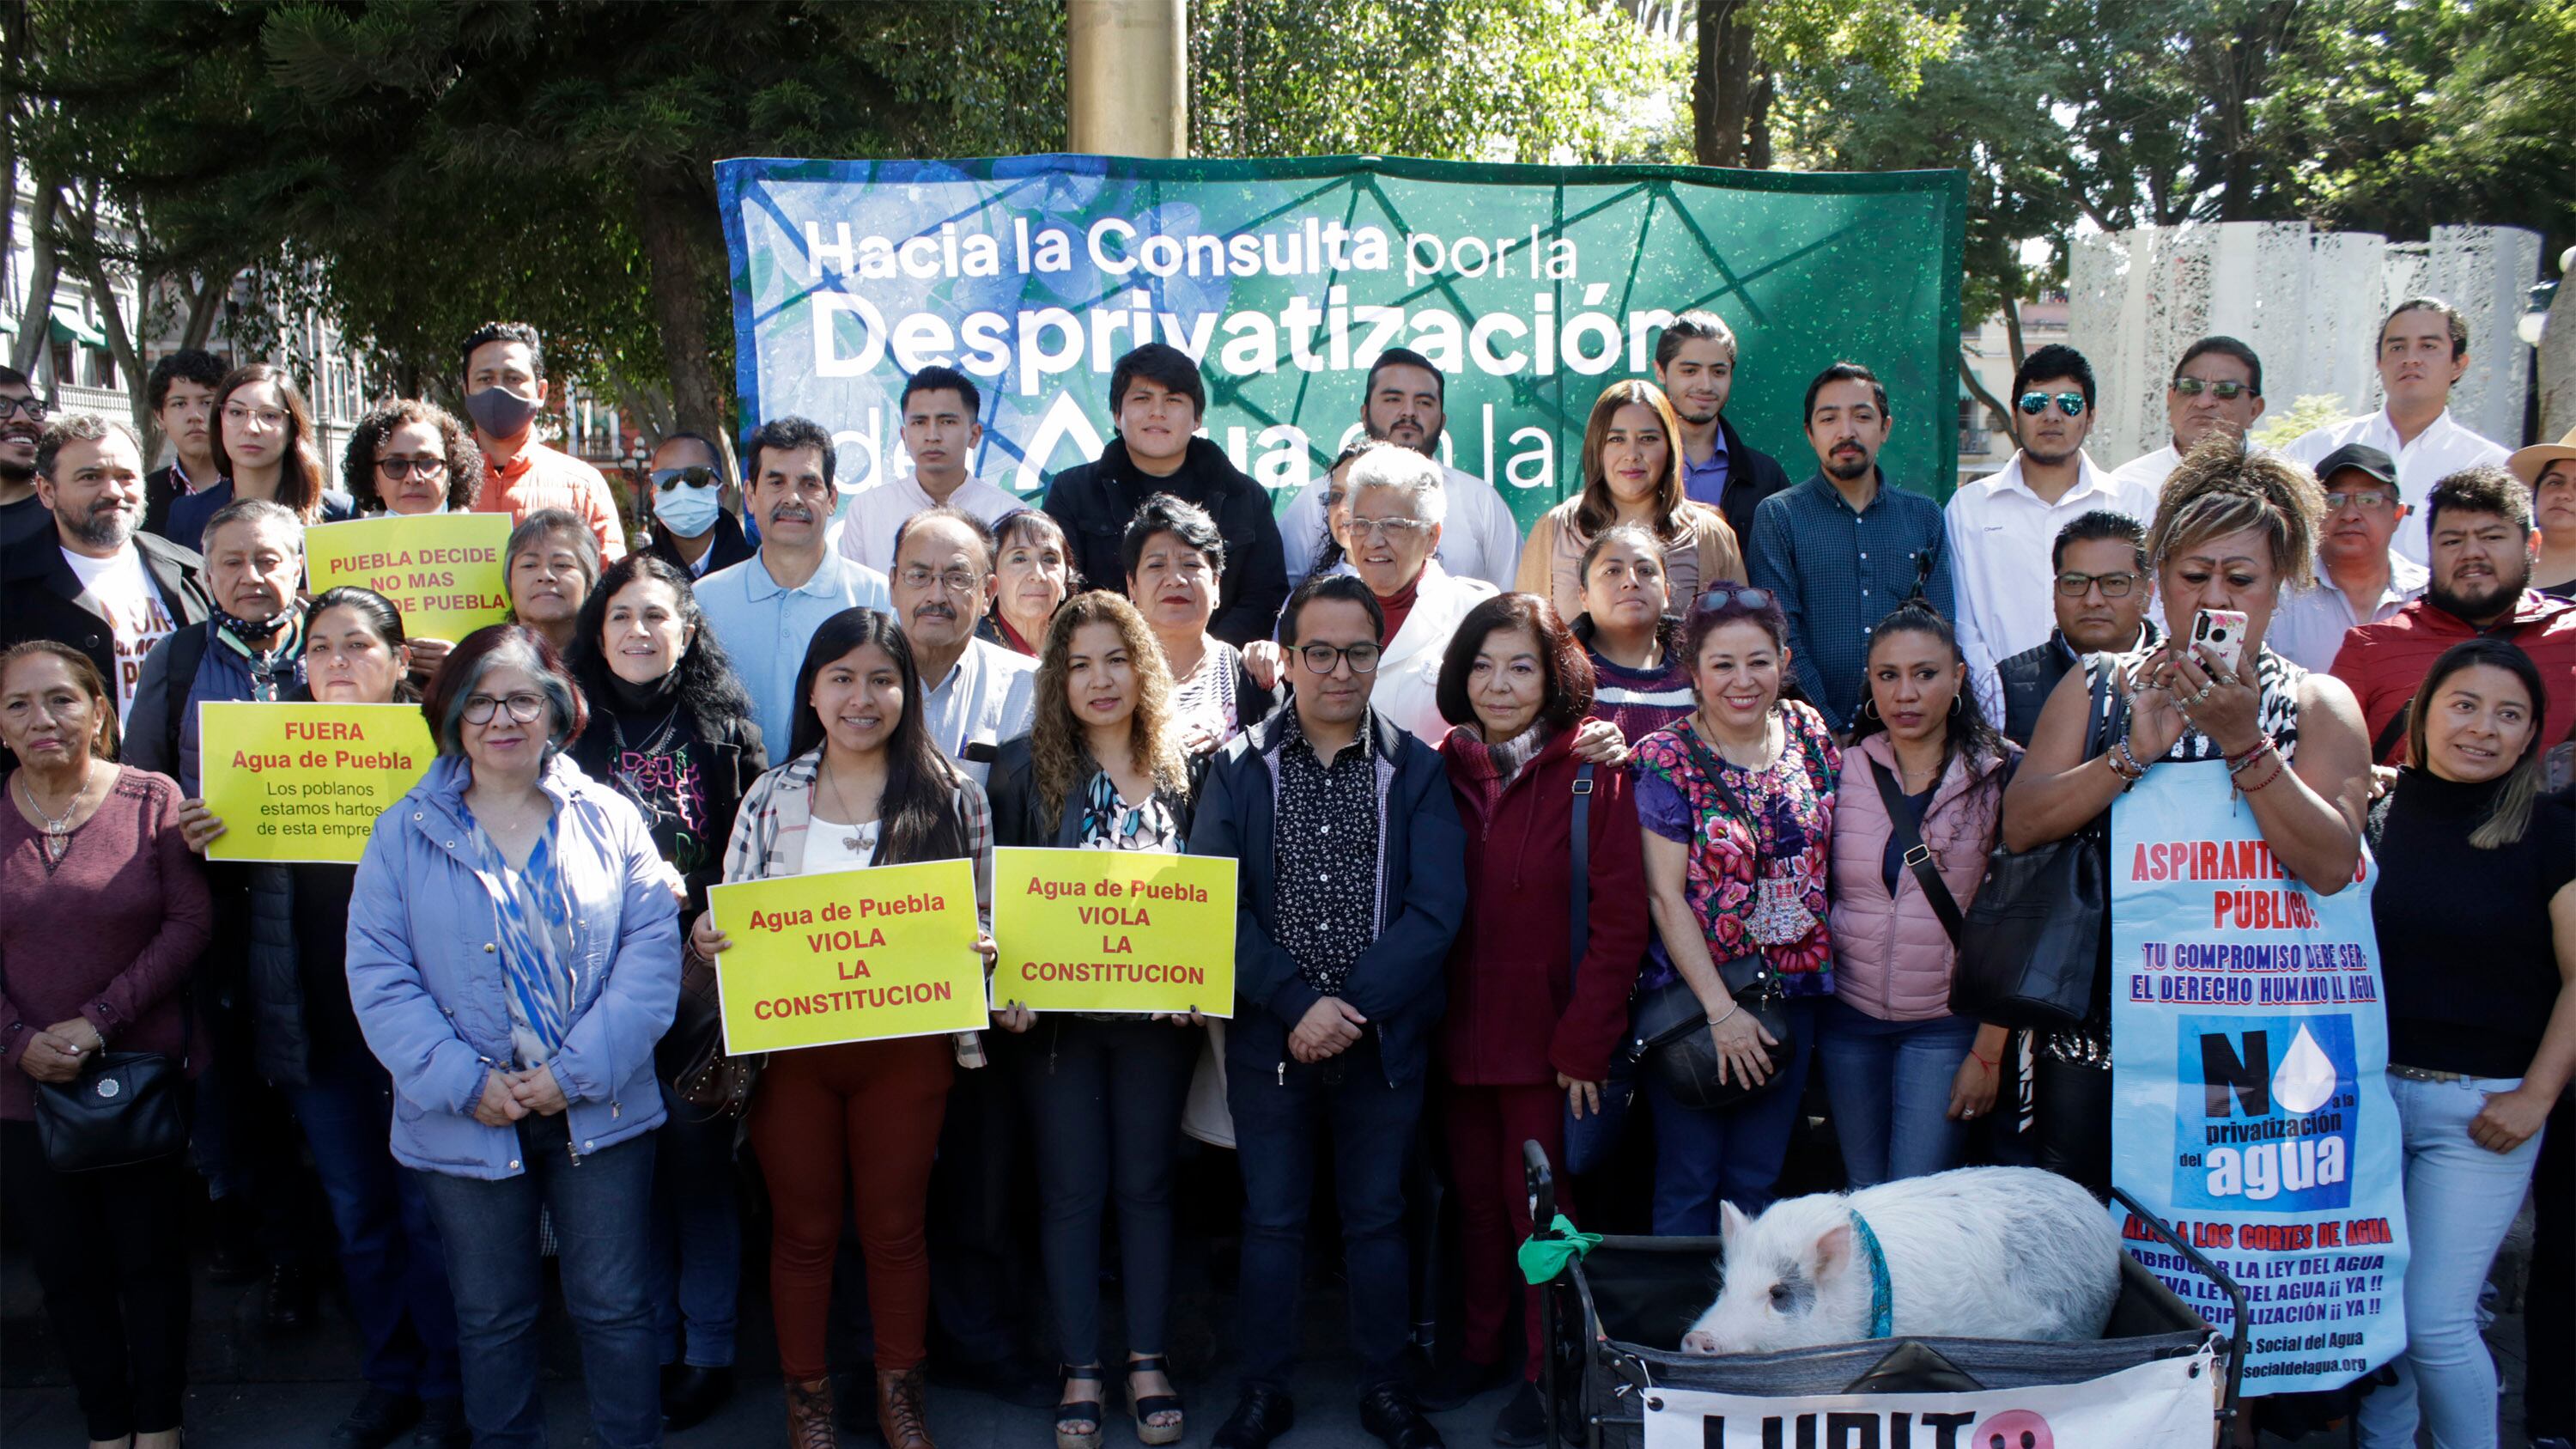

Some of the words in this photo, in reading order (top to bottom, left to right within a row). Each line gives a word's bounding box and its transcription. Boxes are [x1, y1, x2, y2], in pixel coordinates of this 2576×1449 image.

[804, 216, 1001, 279] Hacia
[1014, 216, 1072, 275] la
[1086, 216, 1388, 277] Consulta
[1406, 229, 1517, 287] por
[1530, 223, 1578, 280] la
[811, 283, 1675, 397] Desprivatización
[1482, 404, 1555, 489] la
[331, 551, 412, 575] PUEBLA
[419, 547, 497, 565] DECIDE
[370, 575, 401, 592] NO
[408, 571, 455, 589] MAS
[423, 594, 507, 612] PUEBLA
[285, 722, 364, 740] FUERA
[232, 751, 291, 772] Agua
[299, 751, 328, 769] de
[335, 751, 412, 770] Puebla
[267, 782, 297, 795] Los
[302, 781, 374, 798] poblanos
[260, 802, 331, 816] estamos
[335, 801, 384, 817] hartos
[257, 822, 276, 835] de
[283, 822, 317, 835] esta
[322, 824, 372, 838] empre
[1026, 876, 1086, 899] Agua
[1094, 878, 1124, 898] de
[1130, 880, 1208, 903] Puebla
[749, 908, 814, 934] Agua
[821, 901, 851, 923] de
[859, 892, 945, 919] Puebla
[1078, 905, 1151, 927] VIOLA
[2214, 885, 2320, 929] PÚBLICO:
[807, 928, 886, 954] VIOLA
[1103, 935, 1133, 954] LA
[2142, 942, 2167, 971] TU
[2173, 943, 2301, 972] COMPROMISO
[2306, 943, 2338, 971] DEBE
[838, 959, 872, 982] LA
[1021, 961, 1205, 985] CONSTITUCION
[754, 980, 952, 1021] CONSTITUCION
[2130, 973, 2154, 1002] EL
[2160, 974, 2254, 1004] DERECHO
[2259, 976, 2329, 1004] HUMANO
[2331, 975, 2347, 1002] AL
[2348, 975, 2377, 1002] AGUA
[2331, 1095, 2340, 1108] a
[2342, 1094, 2354, 1107] la
[2205, 1112, 2342, 1146] privatización
[2179, 1153, 2202, 1167] del
[2206, 1135, 2346, 1200] agua
[2194, 1221, 2234, 1249] LOS
[2239, 1223, 2314, 1251] CORTES
[2317, 1221, 2342, 1247] DE
[2346, 1217, 2393, 1246] AGUA
[2131, 1248, 2230, 1277] ABROR
[2235, 1261, 2260, 1279] LA
[2265, 1260, 2296, 1279] LEY
[2299, 1257, 2330, 1275] DEL
[2334, 1255, 2385, 1273] AGUA
[2276, 1281, 2326, 1301] AGUA
[2346, 1275, 2366, 1294] YA
[2345, 1298, 2365, 1317] YA
[2256, 1336, 2302, 1355] Social
[2305, 1333, 2326, 1350] del
[2329, 1331, 2364, 1349] Agua
[2243, 1358, 2367, 1379] socialdelagua.org
